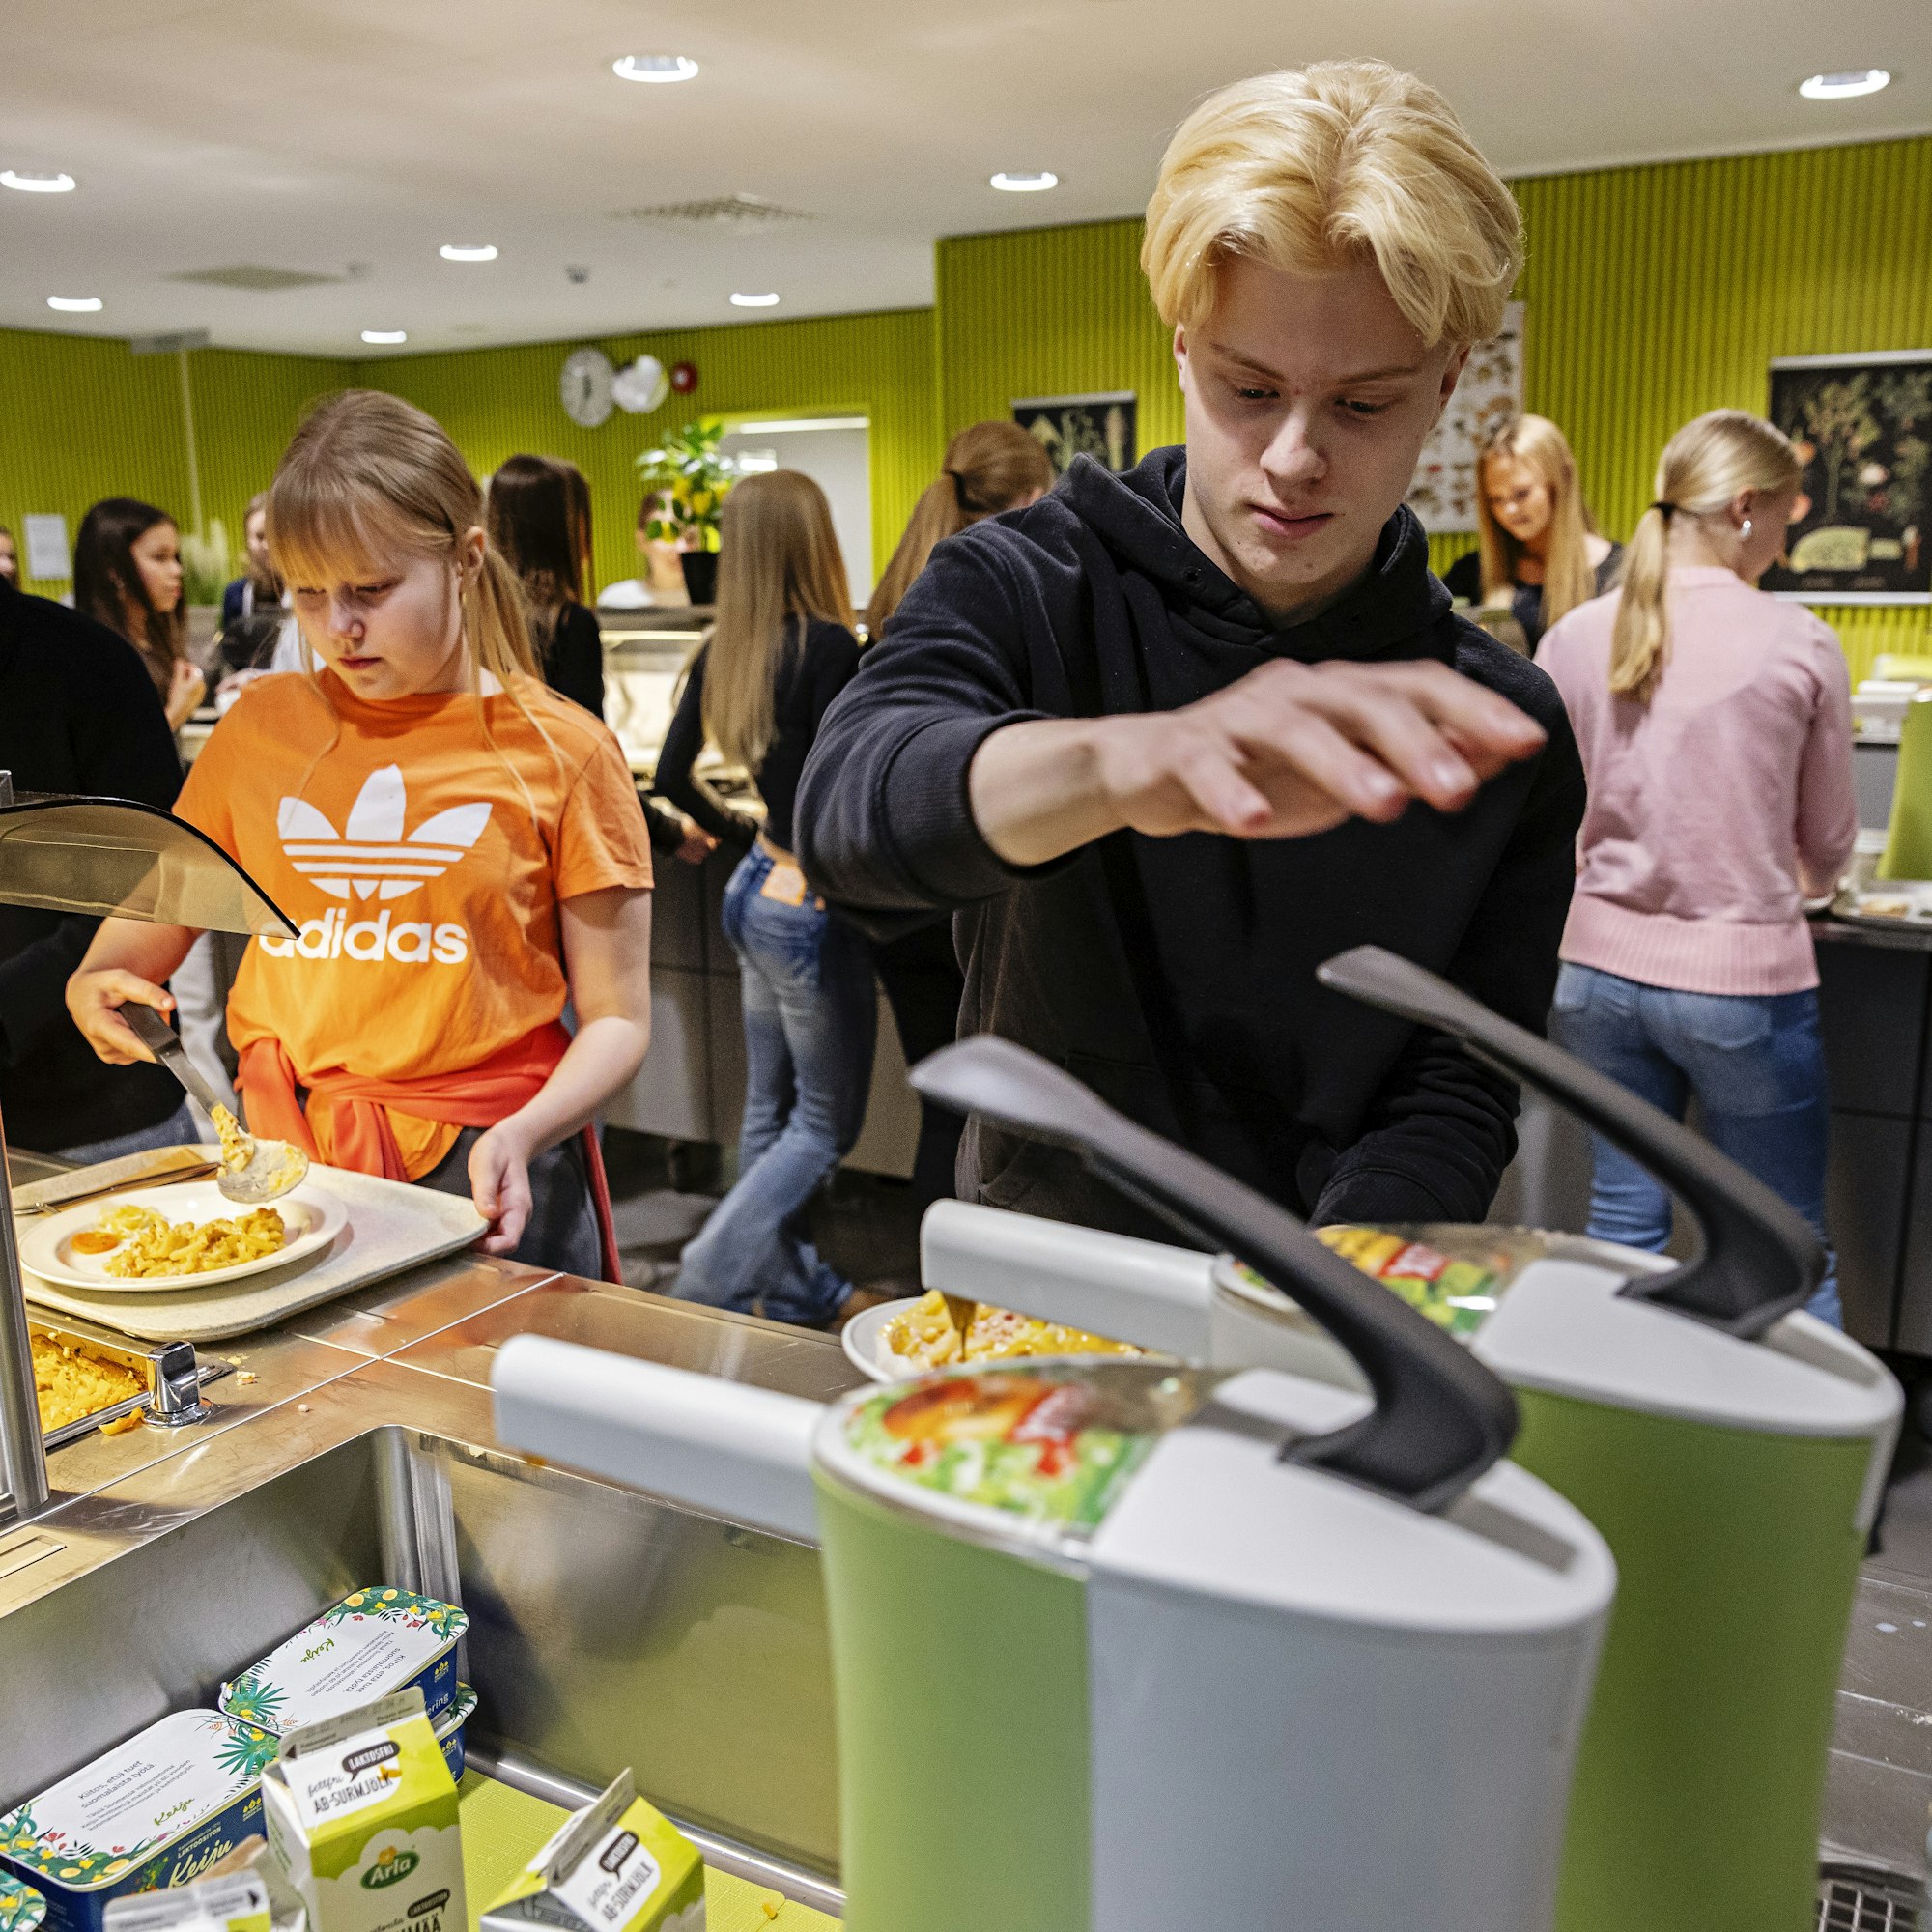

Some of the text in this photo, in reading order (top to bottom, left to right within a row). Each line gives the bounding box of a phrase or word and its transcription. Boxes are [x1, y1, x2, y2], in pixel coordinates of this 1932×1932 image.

[259, 907, 468, 964] adidas
[300, 1638, 335, 1662] Keiju
[361, 1647, 400, 1678] suomalaista
[355, 1654, 406, 1692] Kiitos, että tuet
[424, 1692, 449, 1716] ering
[348, 1745, 394, 1771] LAKTOSFRI
[78, 1760, 143, 1799] Kiitos, että tuet
[81, 1777, 133, 1808] suomalaista
[314, 1775, 394, 1814] AB-SURMJÖLK
[154, 1798, 196, 1826] Keiju
[168, 1839, 233, 1888] Keiju
[370, 1857, 411, 1885] Arla
